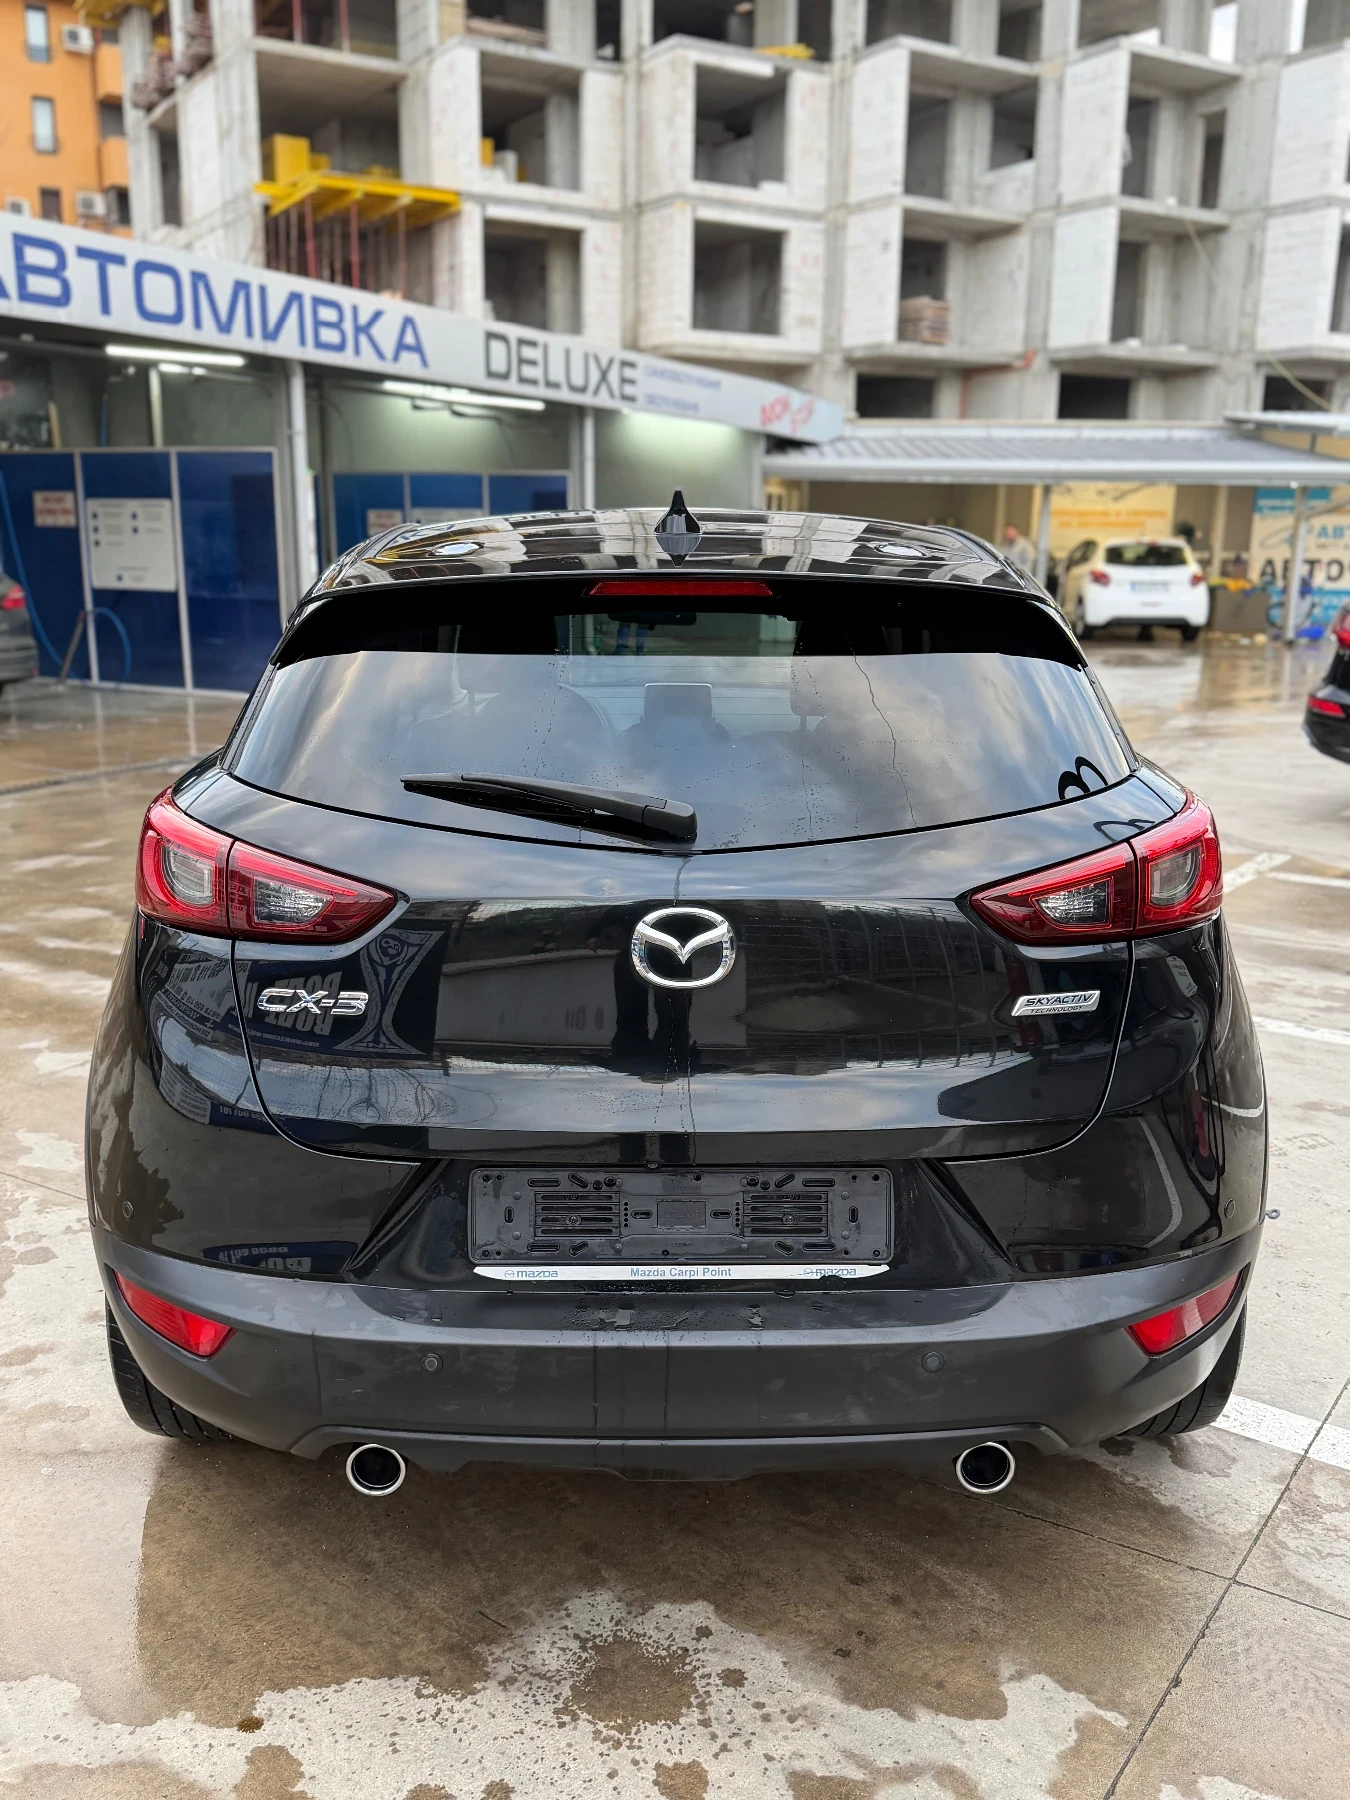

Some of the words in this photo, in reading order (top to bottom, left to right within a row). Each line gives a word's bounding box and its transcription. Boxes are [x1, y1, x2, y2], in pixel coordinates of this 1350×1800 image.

[0, 232, 430, 369] ВТОМИВКА
[484, 330, 638, 402] DELUXE
[257, 987, 369, 1016] CX-3
[1025, 993, 1095, 1007] SKYACTIV
[1030, 1005, 1085, 1015] TECHNOLOGY
[630, 1267, 666, 1277] Mazda
[669, 1267, 699, 1278] Carpi
[702, 1267, 732, 1277] Point
